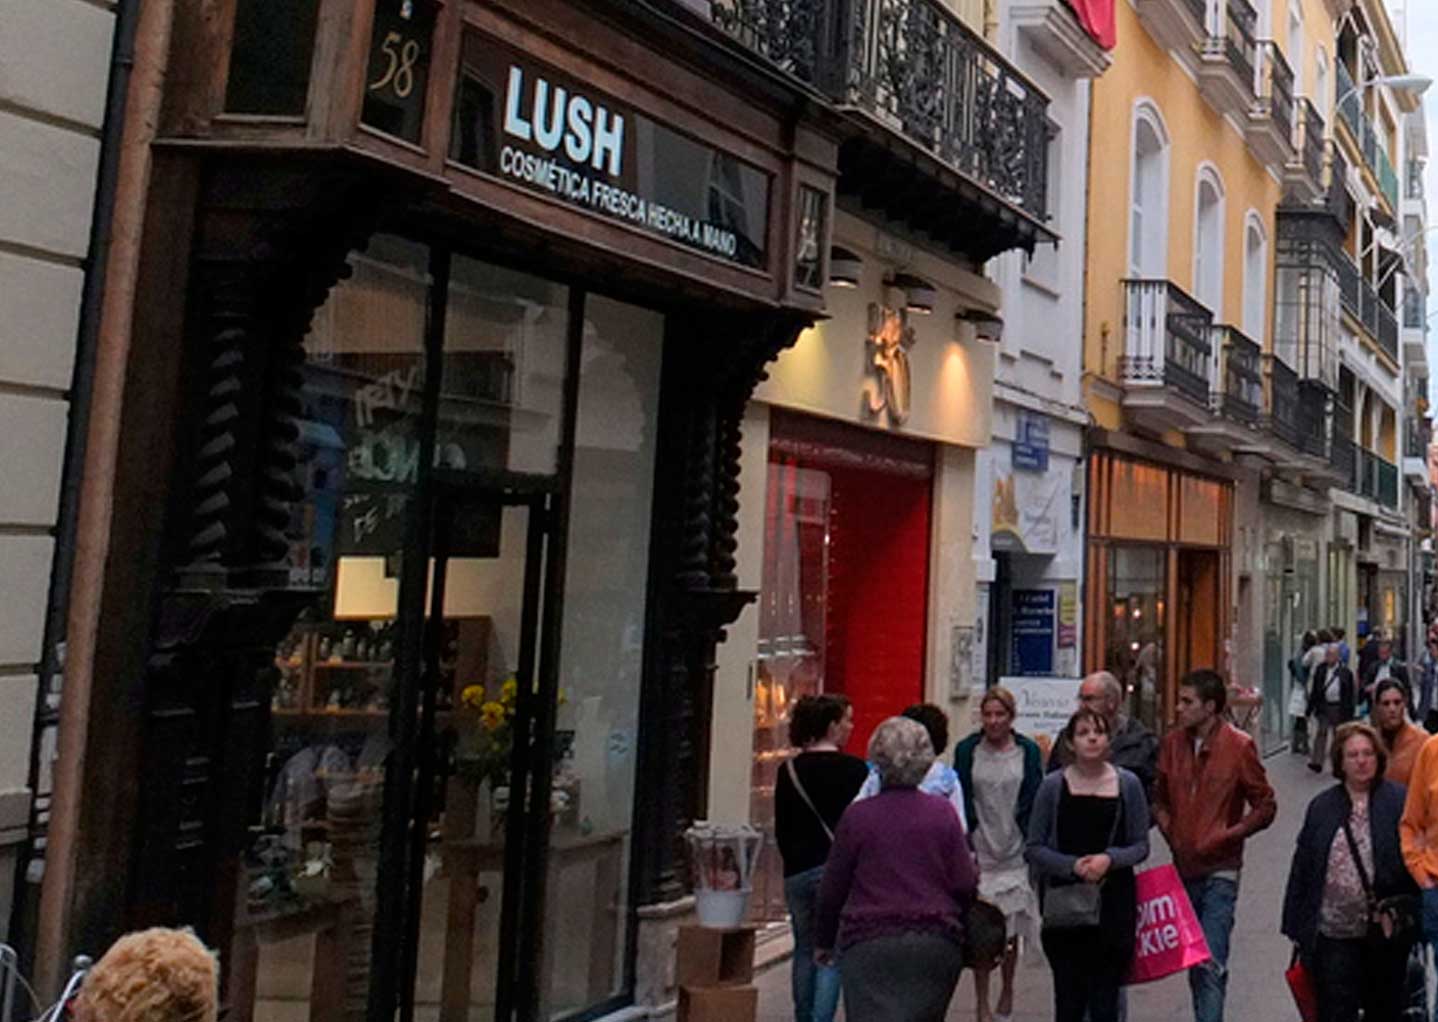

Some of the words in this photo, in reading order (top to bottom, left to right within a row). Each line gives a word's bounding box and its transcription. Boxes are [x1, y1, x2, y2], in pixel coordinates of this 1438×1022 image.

[369, 31, 420, 98] 58
[502, 65, 625, 177] LUSH
[500, 145, 591, 204] COSMÉTICA
[591, 181, 647, 226] FRESCA
[648, 202, 690, 239] HECHA
[702, 222, 738, 257] MANO
